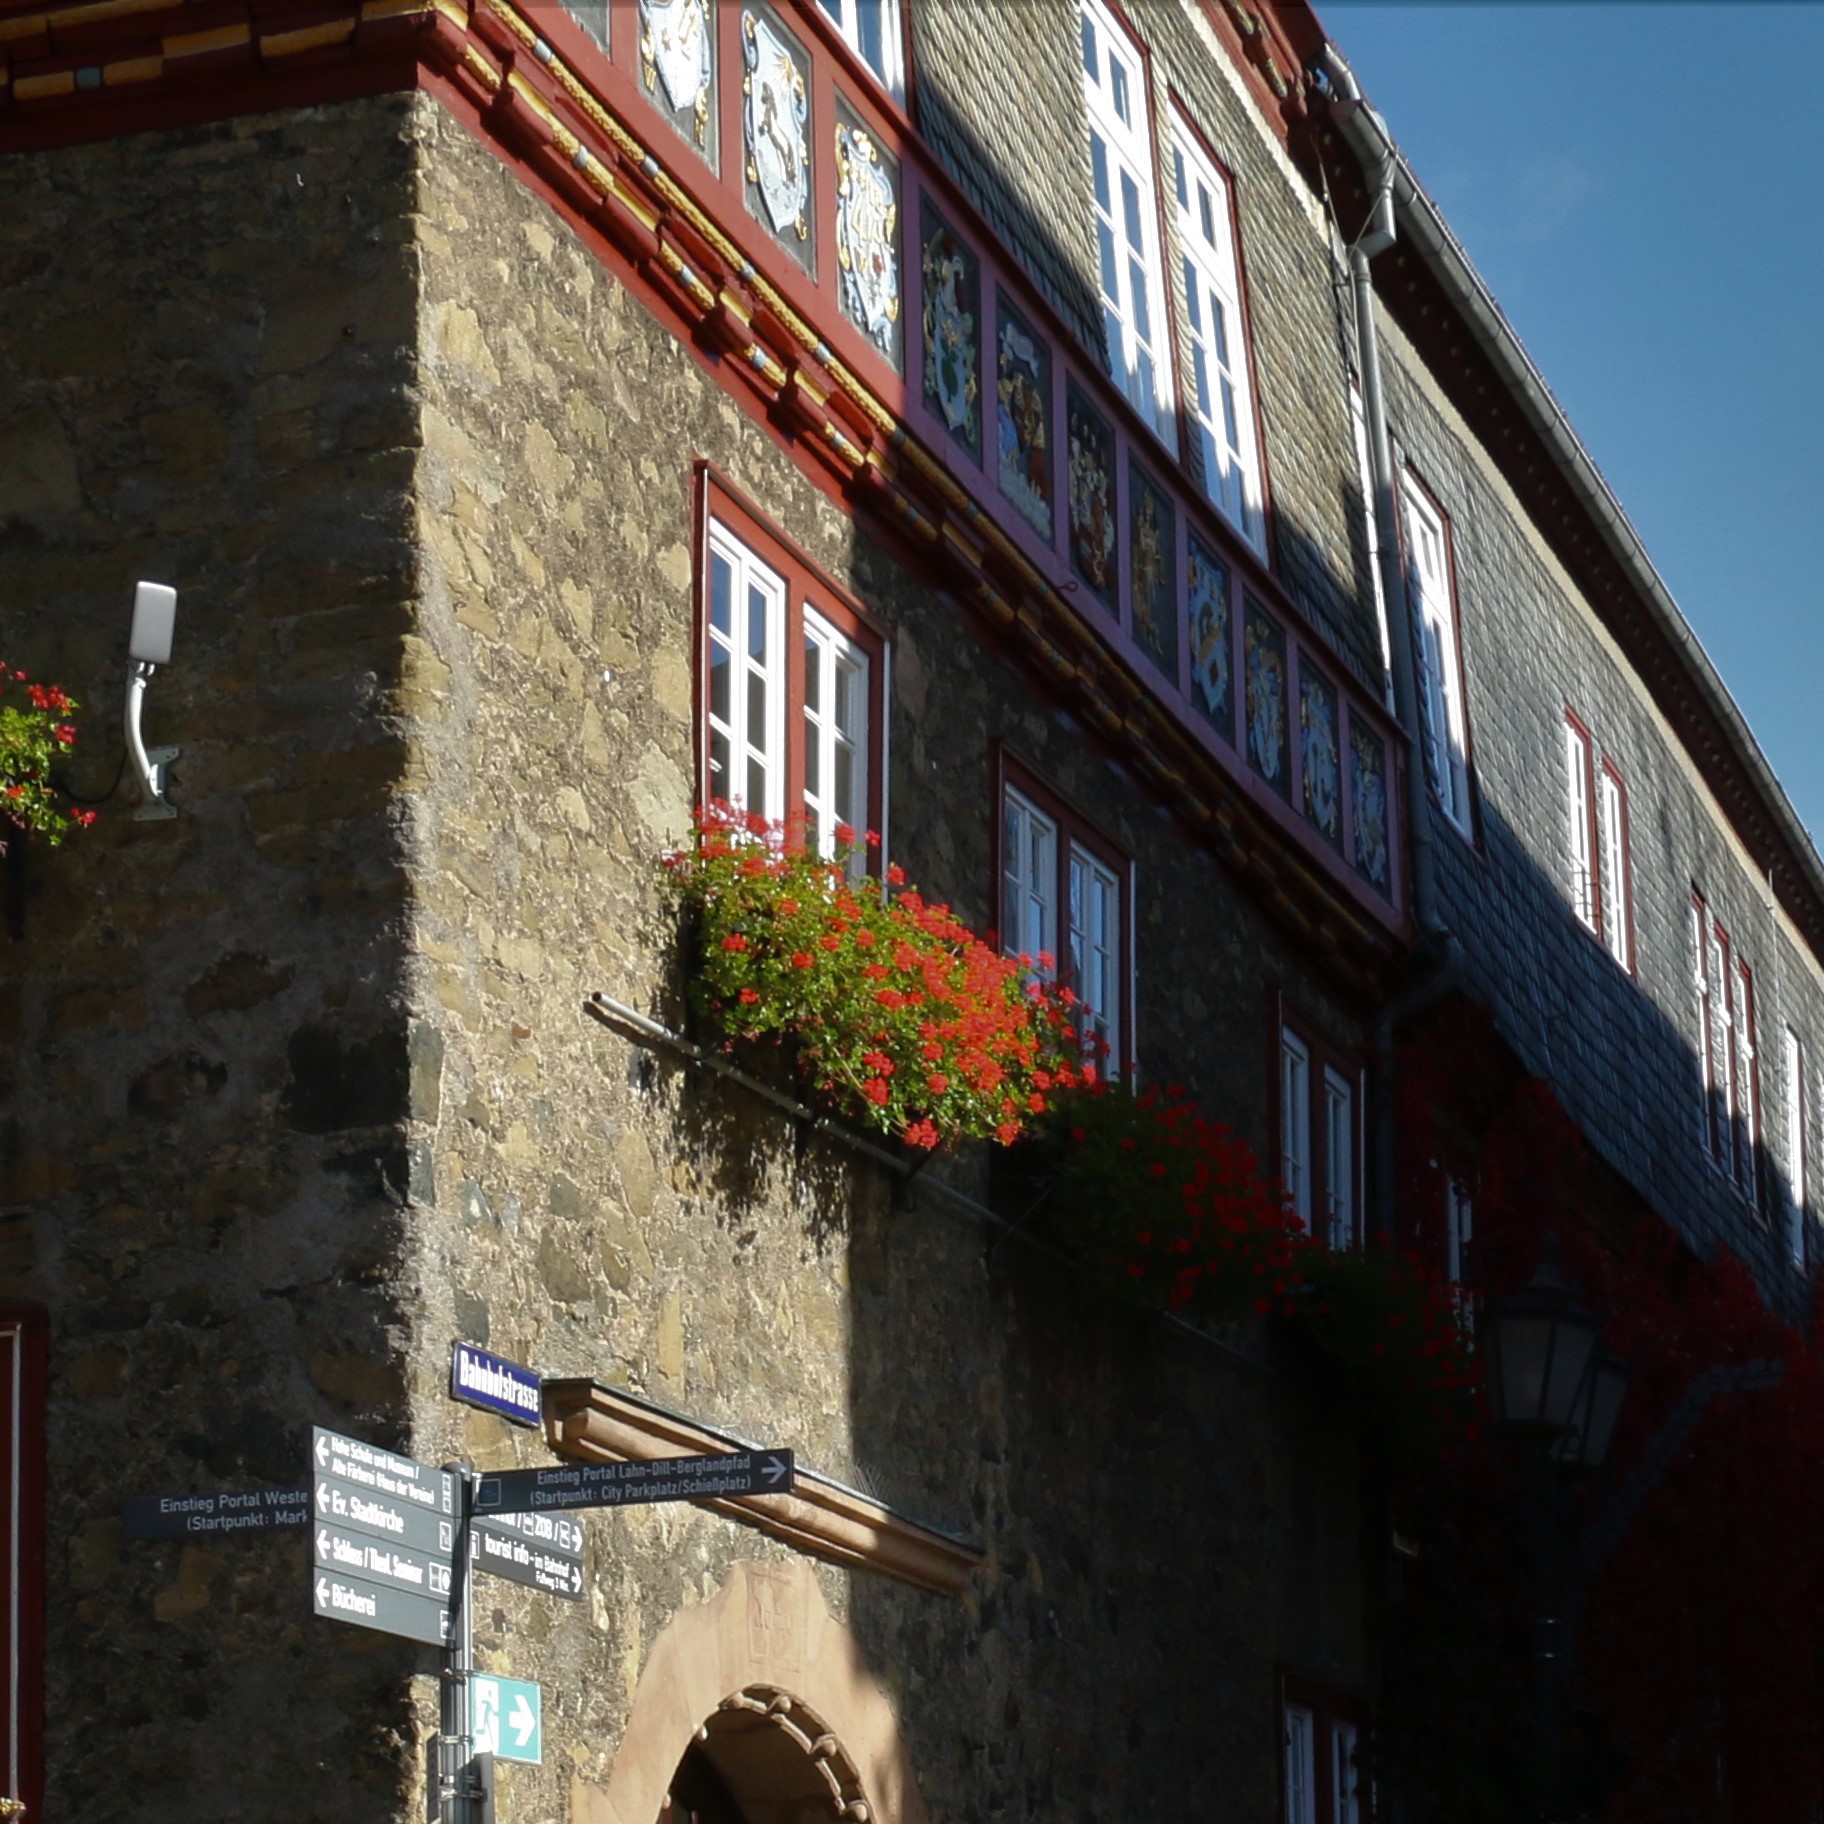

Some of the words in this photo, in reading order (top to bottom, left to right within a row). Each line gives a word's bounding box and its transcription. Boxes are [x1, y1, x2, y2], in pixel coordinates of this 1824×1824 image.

[460, 1349, 539, 1412] Bahnhofstrasse
[537, 1467, 580, 1486] Einstieg
[583, 1464, 616, 1482] Portal
[619, 1455, 751, 1479] Lahn-Dill-Berglandpfad
[160, 1496, 214, 1514] Einstieg
[219, 1493, 261, 1509] Portal
[530, 1487, 597, 1507] (Startpunkt:
[602, 1485, 622, 1502] City
[626, 1475, 752, 1500] Parkplatz/Schießplatz)
[186, 1514, 270, 1532] (Startpunkt:
[332, 1490, 349, 1516] Ev.
[350, 1496, 404, 1533] Stadtkirche
[485, 1533, 512, 1560] tourist
[513, 1541, 529, 1566] info
[393, 1555, 423, 1584] Seminar
[332, 1583, 376, 1617] Bücherei
